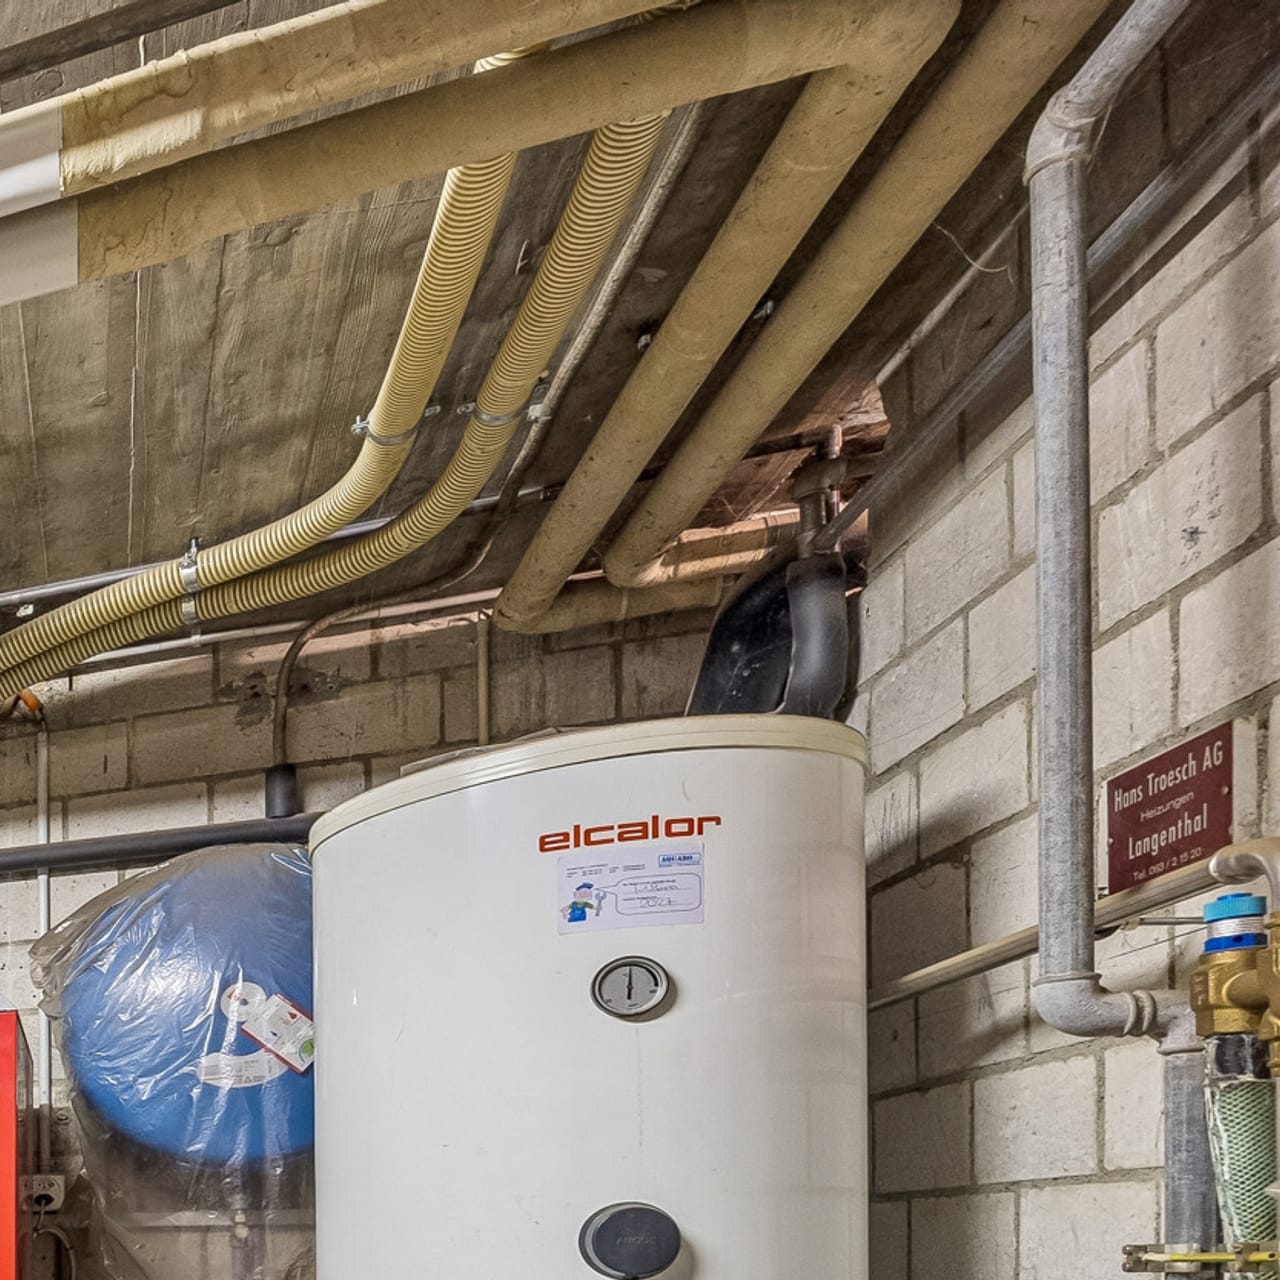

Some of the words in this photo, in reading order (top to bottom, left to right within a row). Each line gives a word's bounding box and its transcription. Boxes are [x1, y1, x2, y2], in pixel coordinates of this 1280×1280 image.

[1114, 784, 1144, 812] Hans
[1147, 752, 1197, 796] Troesch
[1202, 740, 1223, 772] AG
[1140, 791, 1194, 822] Heizungen
[538, 815, 722, 853] elcalor
[1128, 803, 1208, 860] Langenthal
